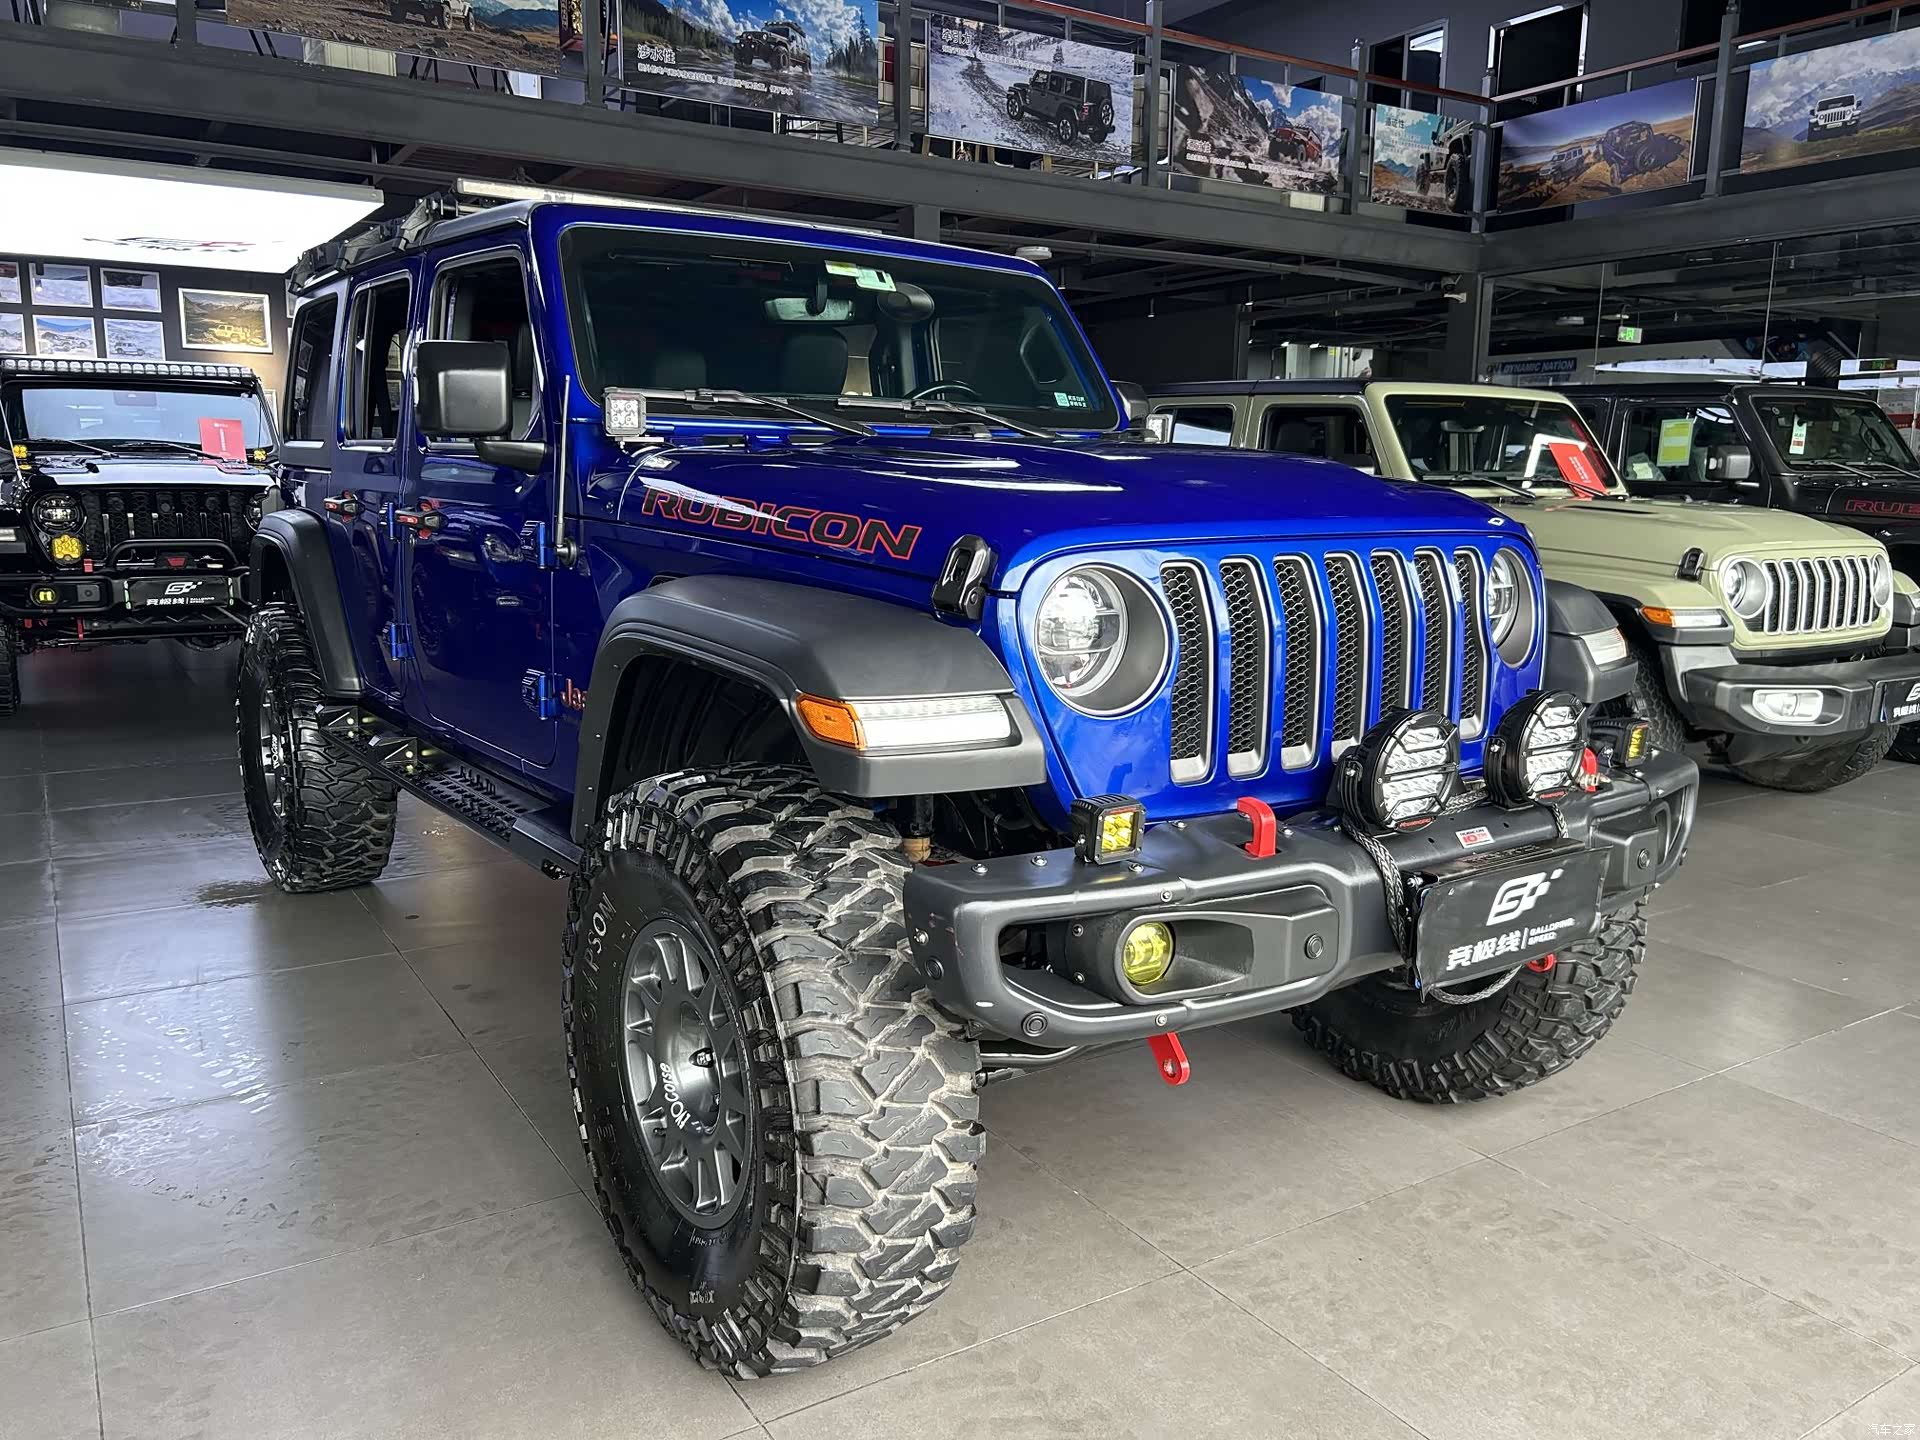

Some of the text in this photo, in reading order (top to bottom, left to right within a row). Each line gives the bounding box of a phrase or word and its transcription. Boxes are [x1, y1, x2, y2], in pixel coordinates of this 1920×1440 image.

[637, 44, 676, 64] 涉水性
[1541, 359, 1574, 372] NATION
[641, 486, 923, 561] RUBICON
